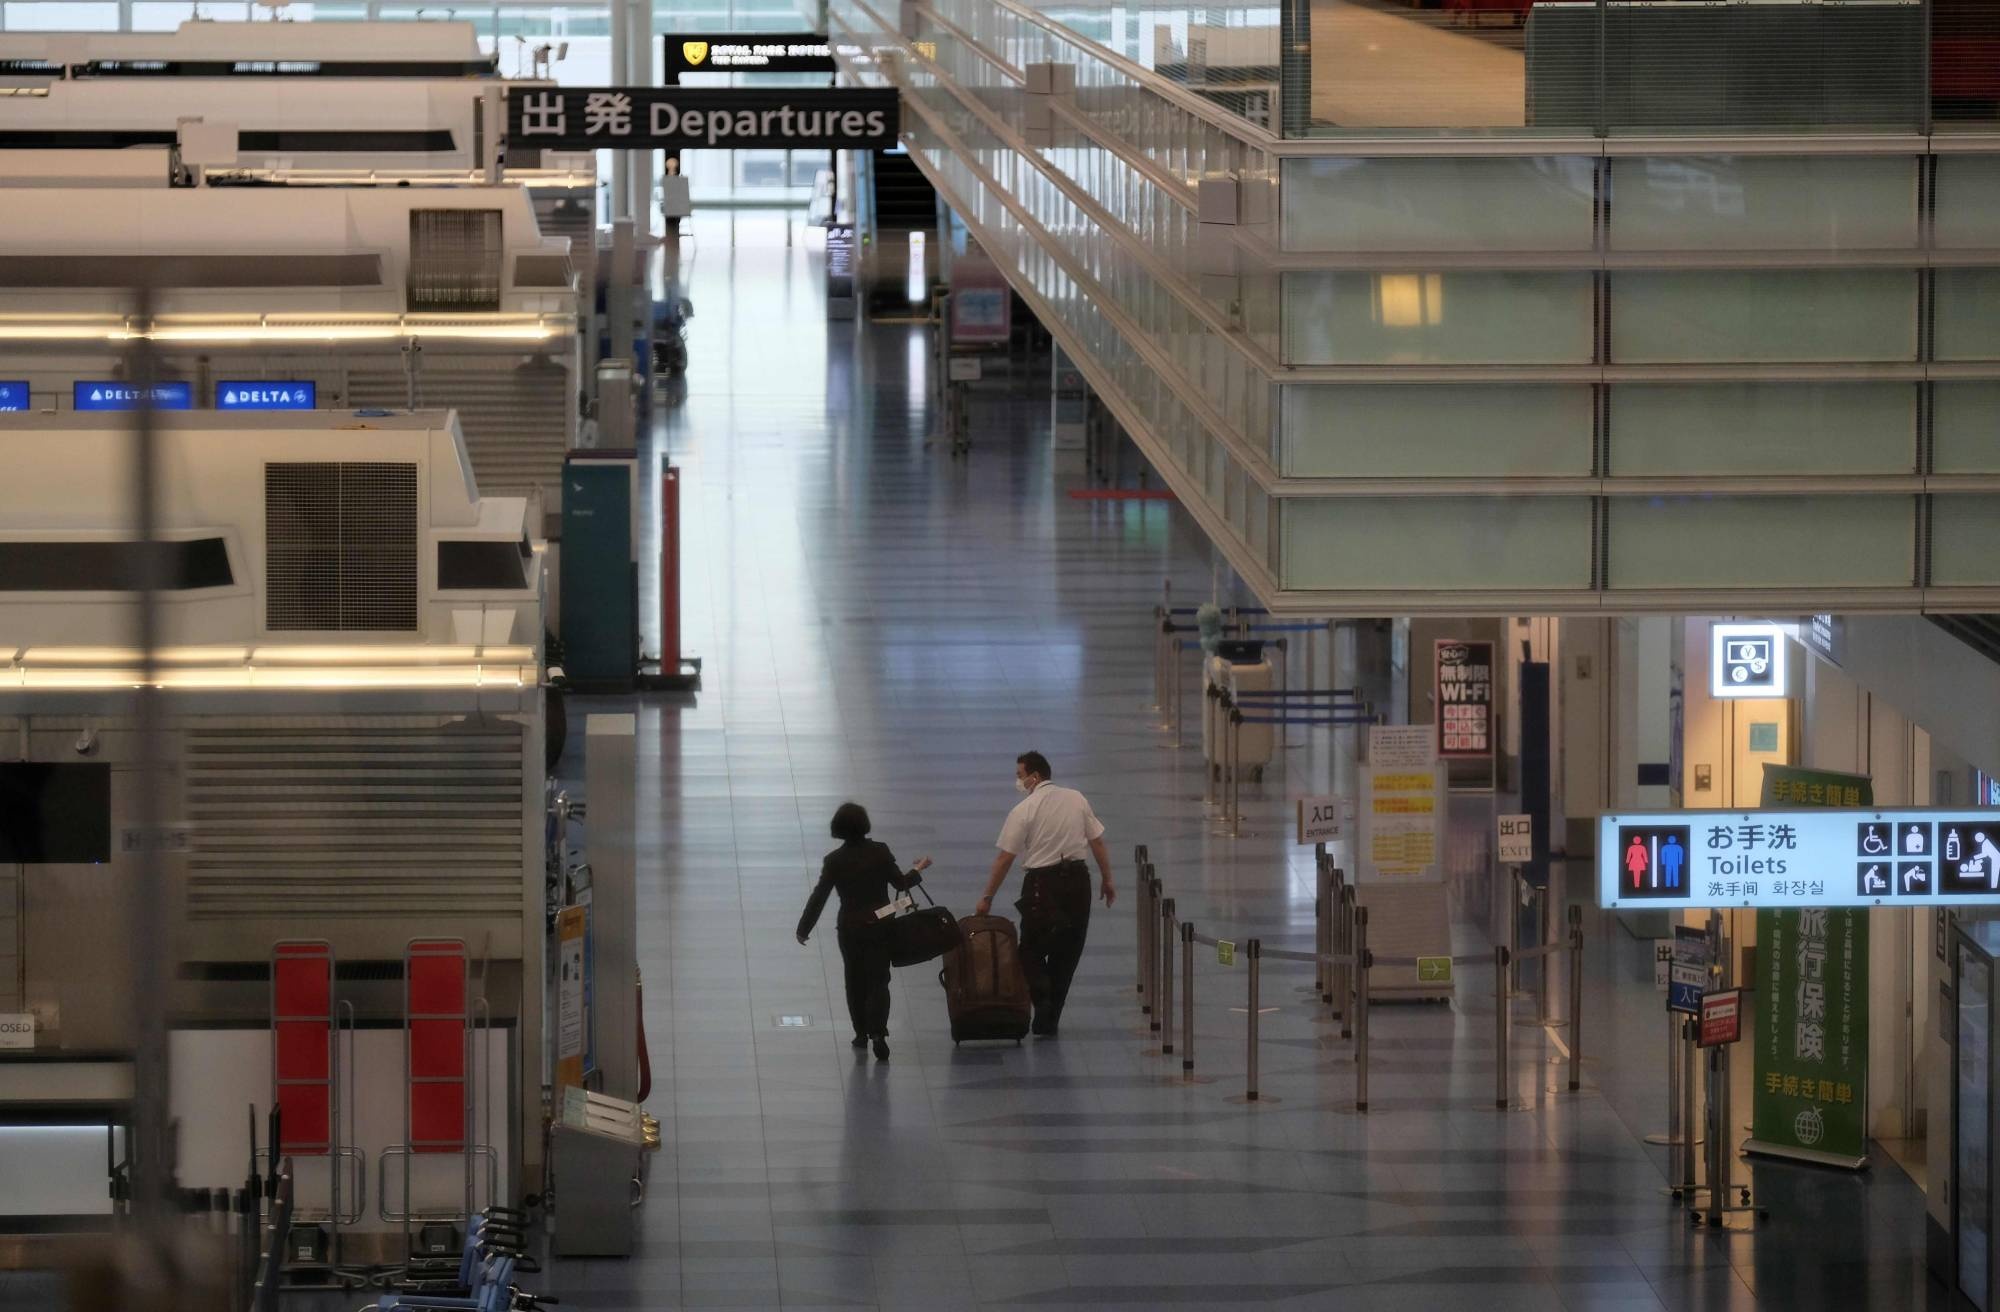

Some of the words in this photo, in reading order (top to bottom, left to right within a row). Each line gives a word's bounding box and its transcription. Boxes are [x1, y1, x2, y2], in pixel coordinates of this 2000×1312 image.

[521, 91, 632, 136] 出発
[649, 102, 885, 145] Departures
[240, 390, 290, 403] DELTA
[1311, 805, 1334, 823] 入口
[1306, 825, 1339, 838] ENTRANCE
[1500, 821, 1530, 836] 出口
[1707, 824, 1797, 850] お手洗
[1500, 846, 1529, 857] EXIT
[1707, 855, 1787, 874] Toilets
[1708, 881, 1758, 897] 洗手间
[1772, 880, 1824, 896] 화장실
[1795, 908, 1828, 1064] 旅行保険
[1765, 1071, 1853, 1104] 手続き簡単
